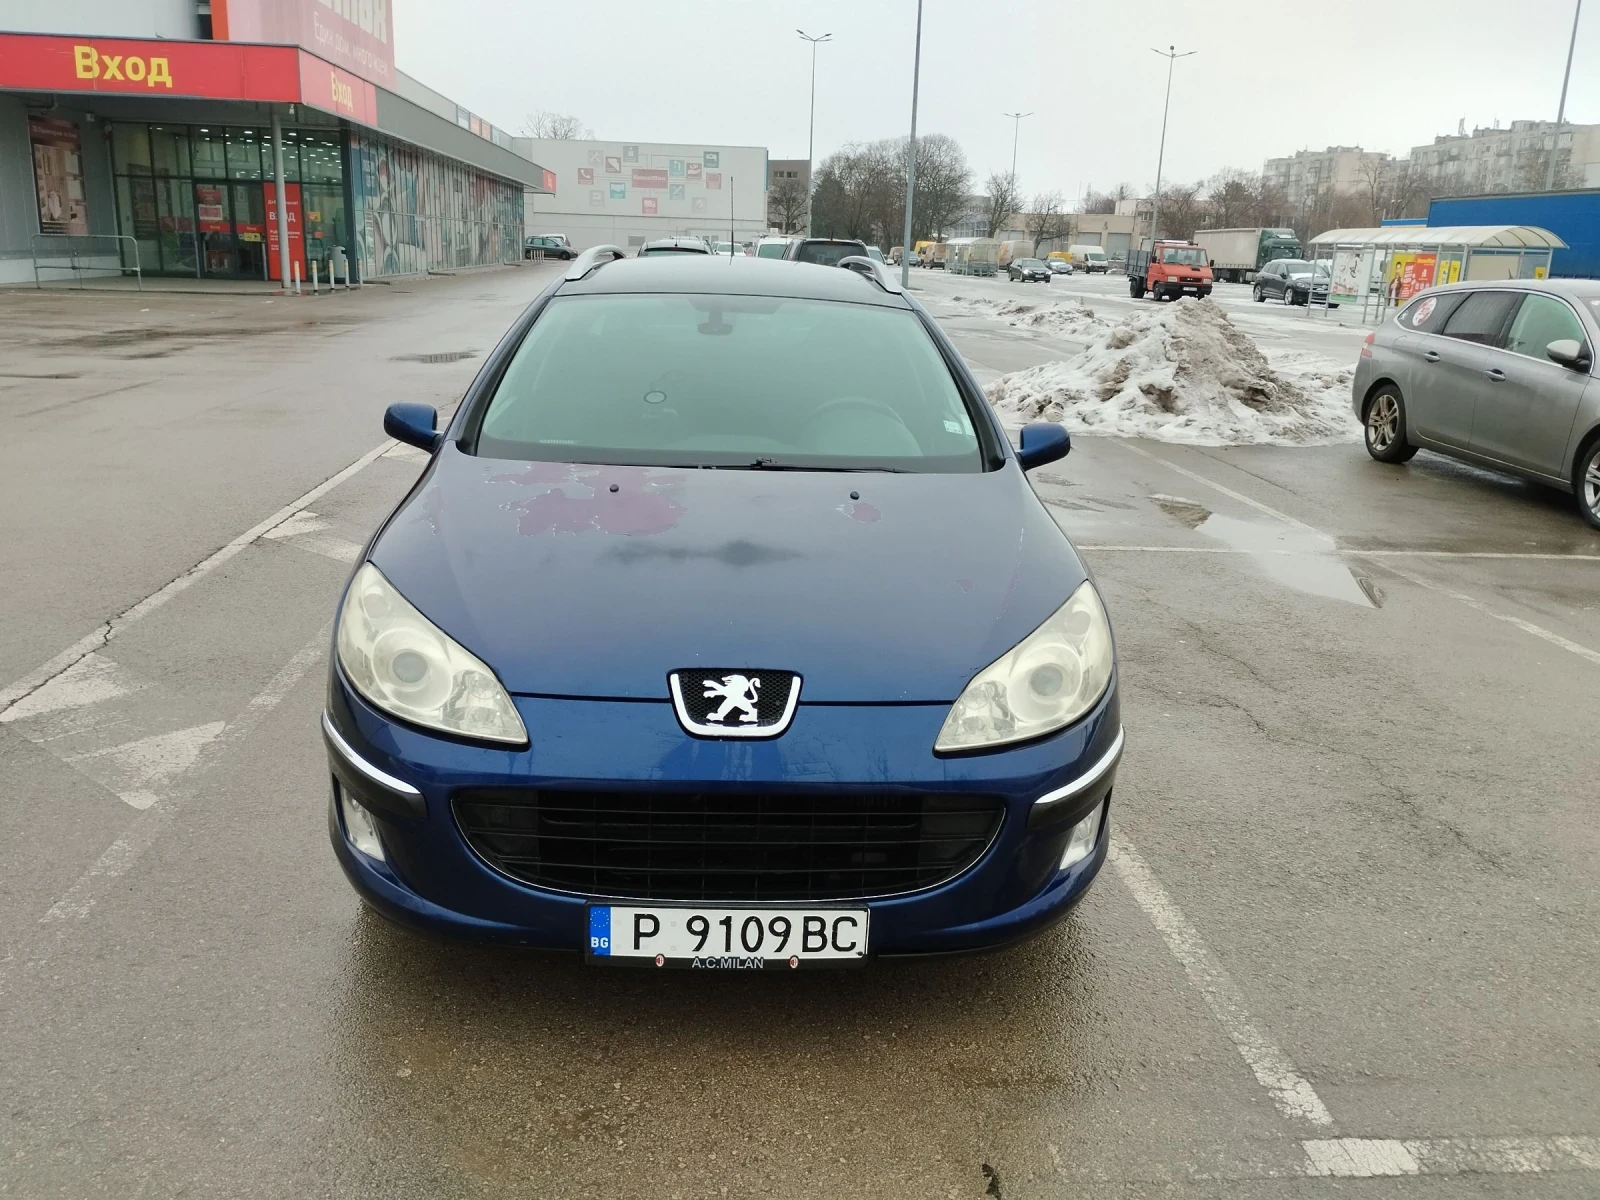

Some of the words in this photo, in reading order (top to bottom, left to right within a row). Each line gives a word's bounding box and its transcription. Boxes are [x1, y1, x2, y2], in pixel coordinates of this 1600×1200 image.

[73, 45, 173, 88] Вход
[330, 71, 354, 113] Вход
[590, 936, 609, 948] BG
[633, 913, 660, 950] P
